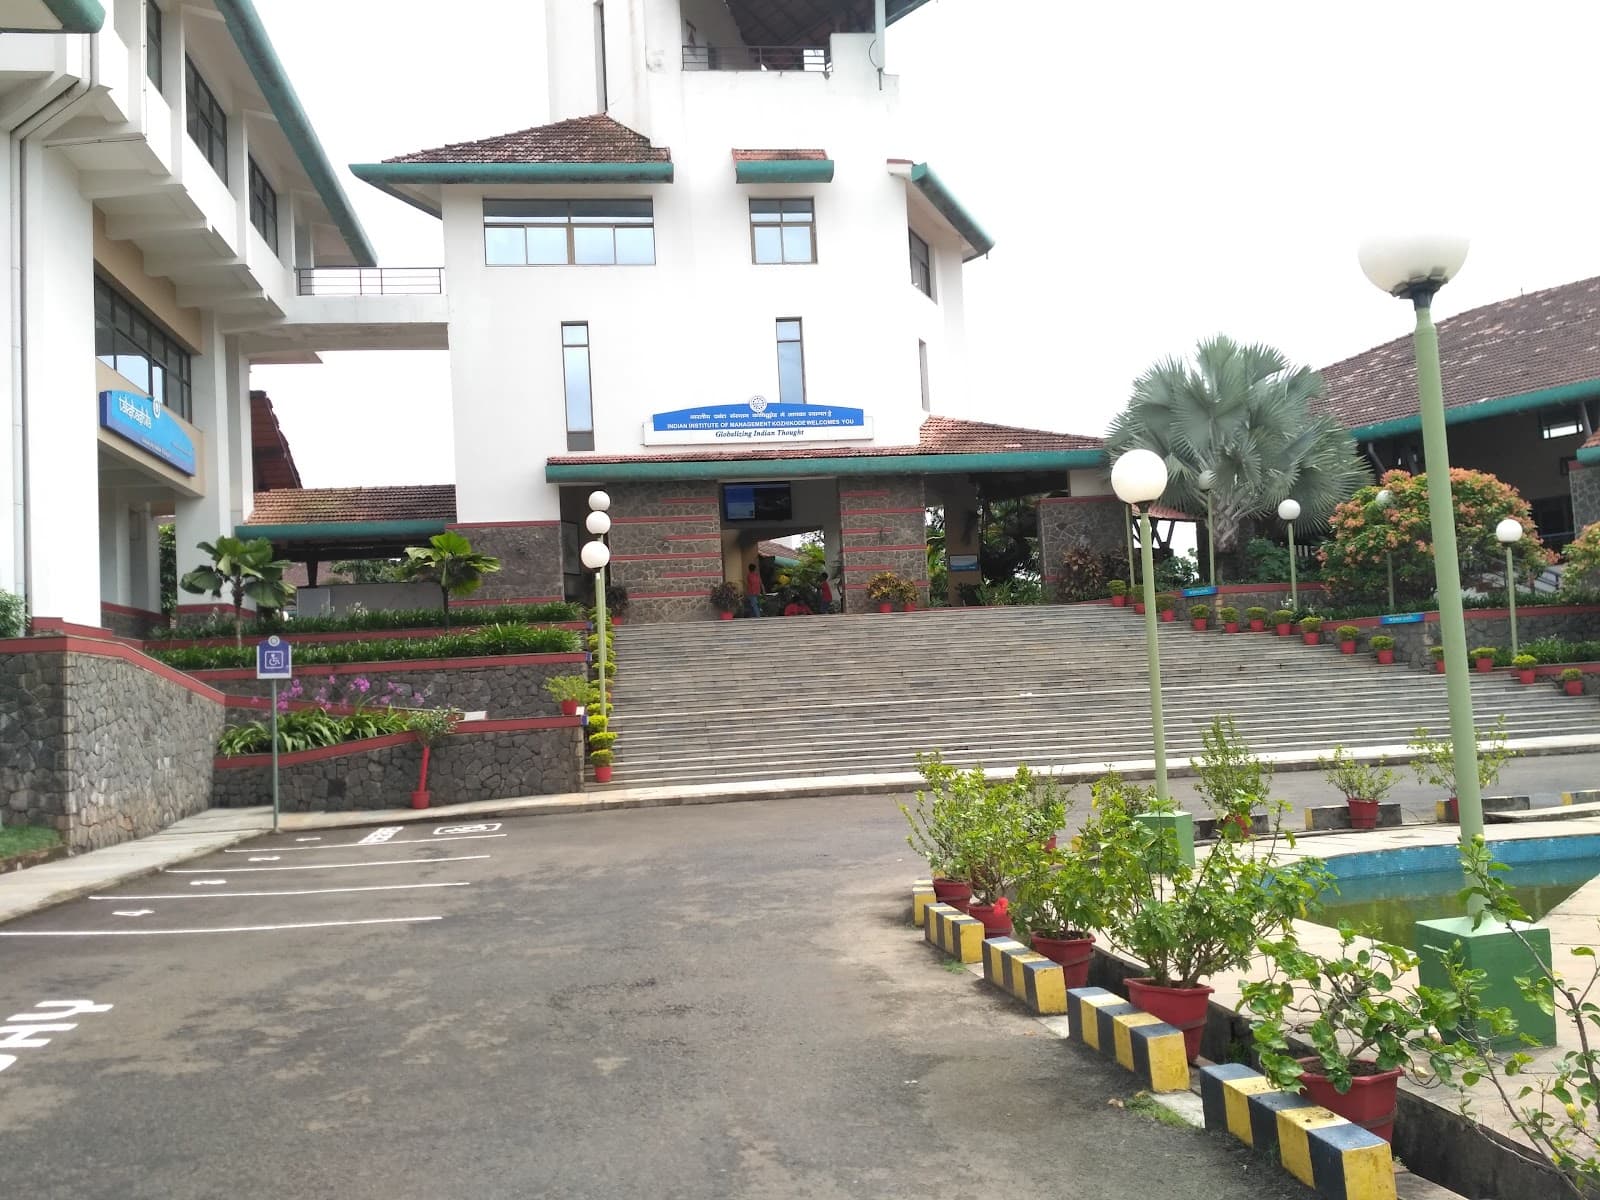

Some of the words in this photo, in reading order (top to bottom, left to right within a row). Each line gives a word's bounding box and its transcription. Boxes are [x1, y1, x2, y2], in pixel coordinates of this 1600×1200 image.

[730, 420, 771, 428] MANAGEMENT
[715, 430, 752, 438] Globalizing
[753, 429, 775, 437] Indian
[777, 428, 804, 437] Thought
[111, 907, 155, 918] 4
